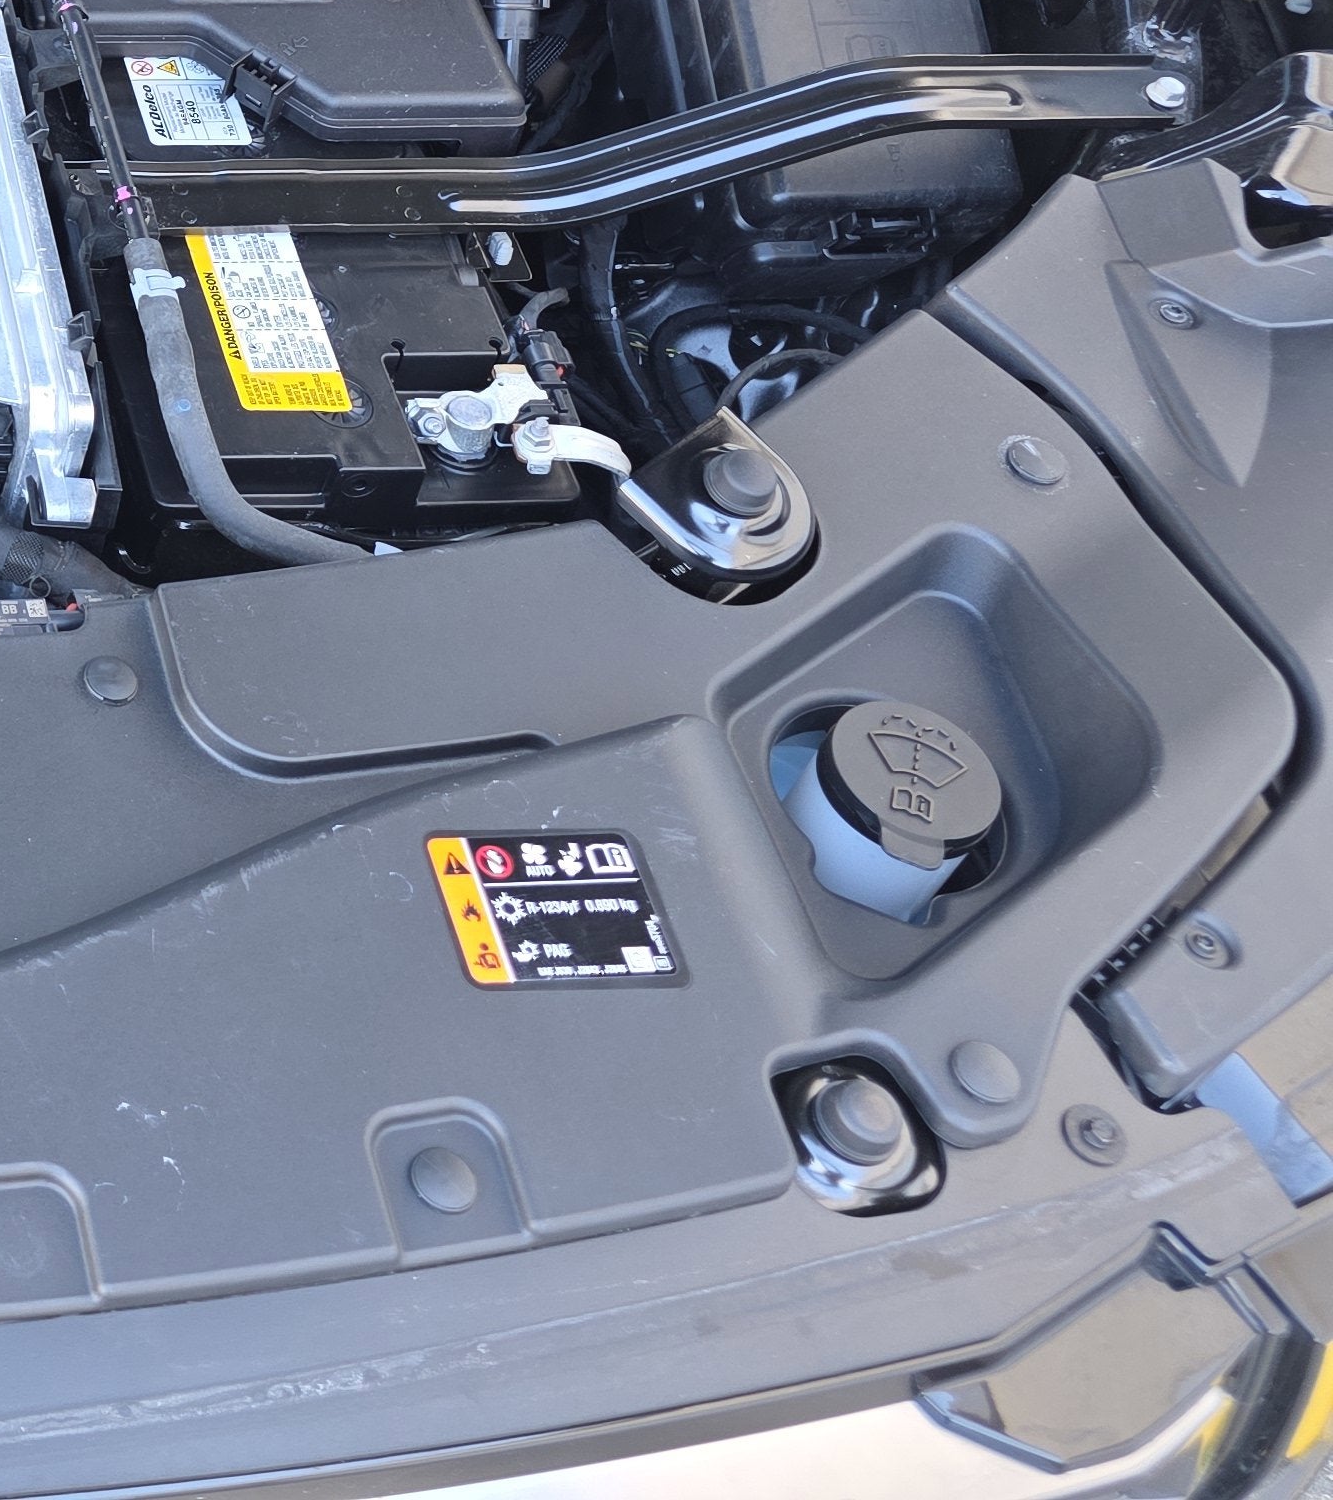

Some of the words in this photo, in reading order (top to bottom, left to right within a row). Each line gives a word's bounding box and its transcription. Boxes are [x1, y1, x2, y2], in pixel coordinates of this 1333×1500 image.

[142, 85, 169, 139] ACDelco
[185, 100, 202, 124] 8540
[202, 272, 238, 349] DANGER/POISON
[1, 604, 18, 615] BB
[526, 865, 556, 877] AUTO
[525, 900, 580, 915] R-1234yf
[619, 898, 639, 913] kg
[543, 943, 572, 958] PAG
